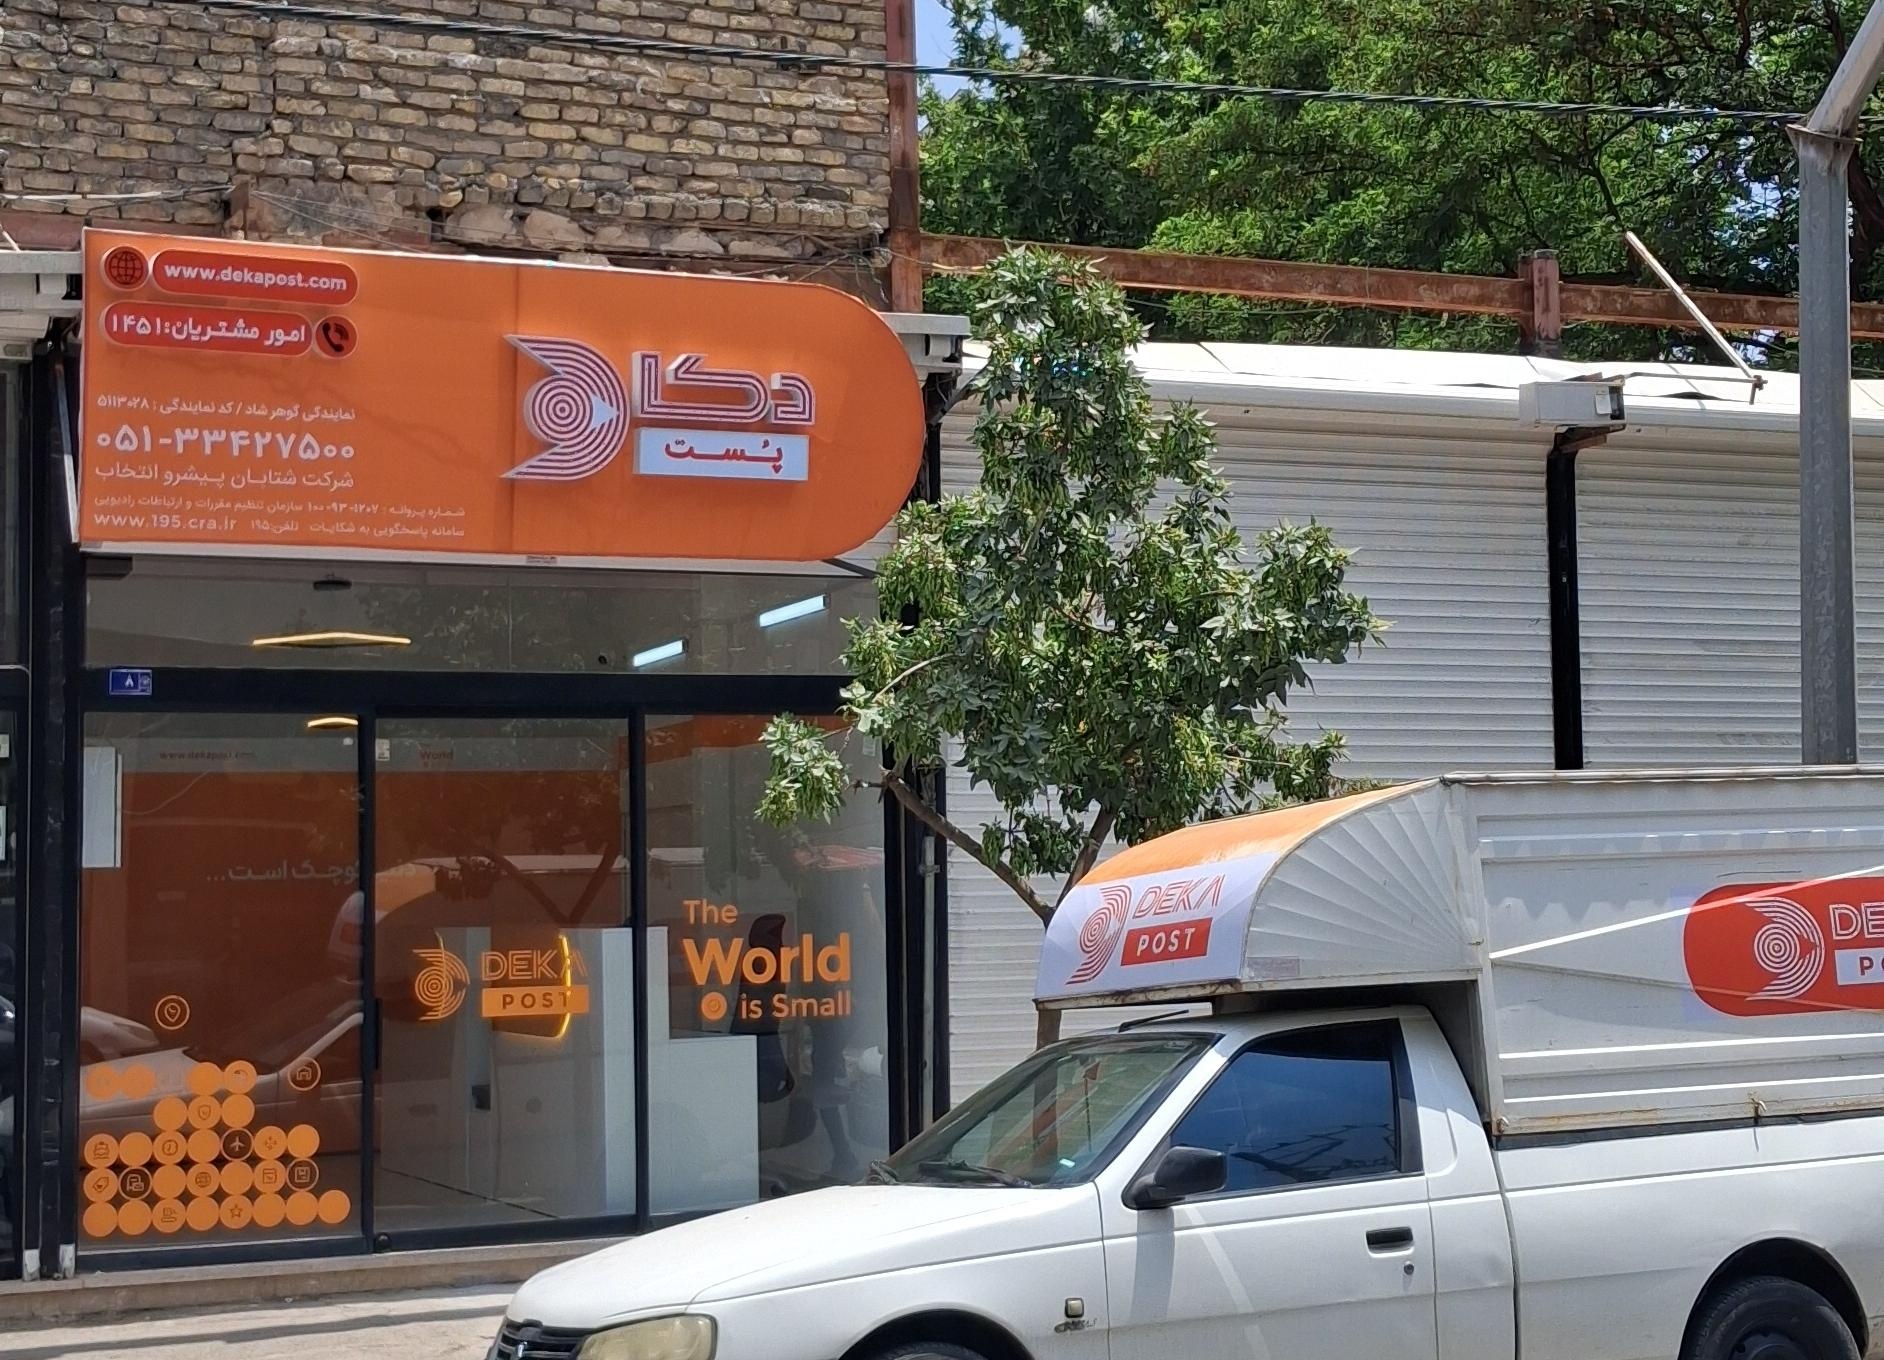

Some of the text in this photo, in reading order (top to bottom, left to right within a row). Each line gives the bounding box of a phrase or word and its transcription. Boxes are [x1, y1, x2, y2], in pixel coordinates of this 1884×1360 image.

[164, 263, 347, 290] www.dekapost.com
[264, 325, 306, 346] امور
[632, 351, 816, 426] دکا
[218, 401, 234, 415] کد
[302, 403, 356, 422] نمایندگی
[97, 424, 355, 460] ۰۵۱-۳۳۴۲۷۵۰۰
[95, 461, 354, 492] شرکت شتابان پیشرو انتخاب
[267, 498, 303, 513] سازمان
[94, 513, 238, 530] www.195.cra.ir
[310, 520, 355, 534] شکایات
[359, 526, 370, 536] به
[431, 524, 465, 537] سامانه
[1132, 874, 1225, 919] DEKA
[683, 899, 738, 924] The
[1137, 928, 1195, 956] POST
[683, 932, 850, 985] World
[740, 991, 850, 1019] is Small
